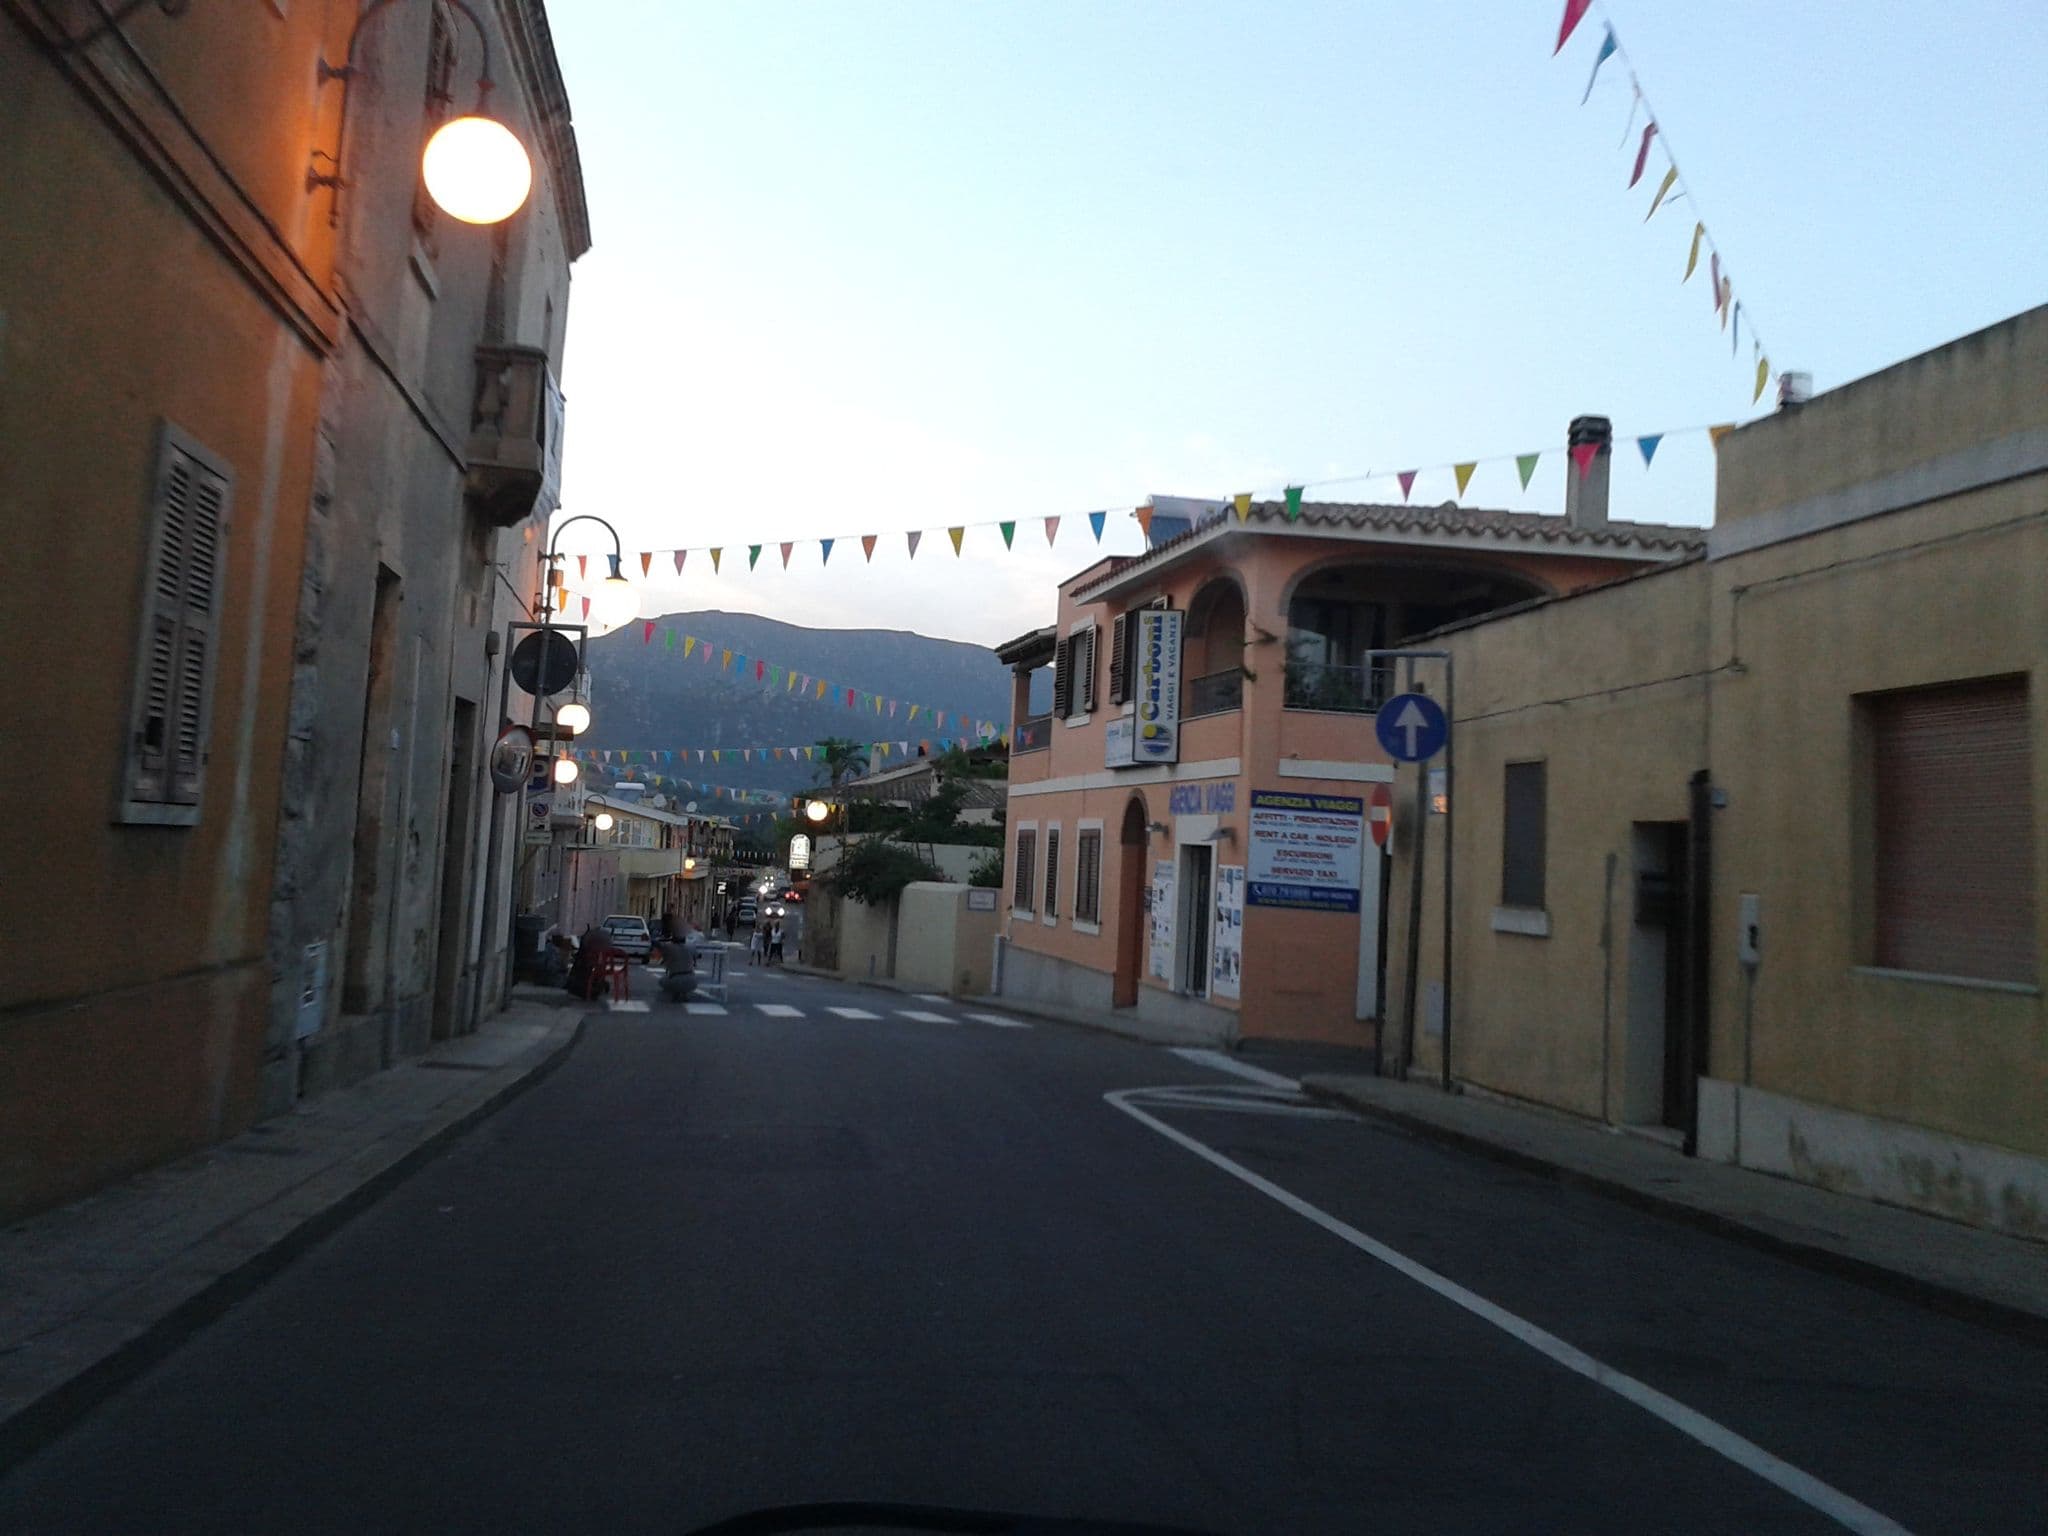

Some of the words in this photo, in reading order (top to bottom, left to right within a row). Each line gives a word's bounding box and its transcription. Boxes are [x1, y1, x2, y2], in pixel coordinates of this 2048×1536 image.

[1168, 615, 1177, 668] VACANZE
[1140, 615, 1163, 721] Carboni
[1166, 682, 1175, 720] VIAGGI
[527, 760, 550, 786] P
[1256, 795, 1312, 808] AGENZIA
[1316, 799, 1360, 811] VIAGGI
[1254, 813, 1286, 821] AFFITTI
[1294, 815, 1359, 827] PRENOTAZIONI
[1254, 830, 1279, 838] RENT
[1316, 834, 1357, 844] NOLEGGI
[1276, 850, 1333, 860] ESCURSIONI
[1271, 867, 1314, 877] SERVIZIO
[1317, 870, 1338, 878] TAXI
